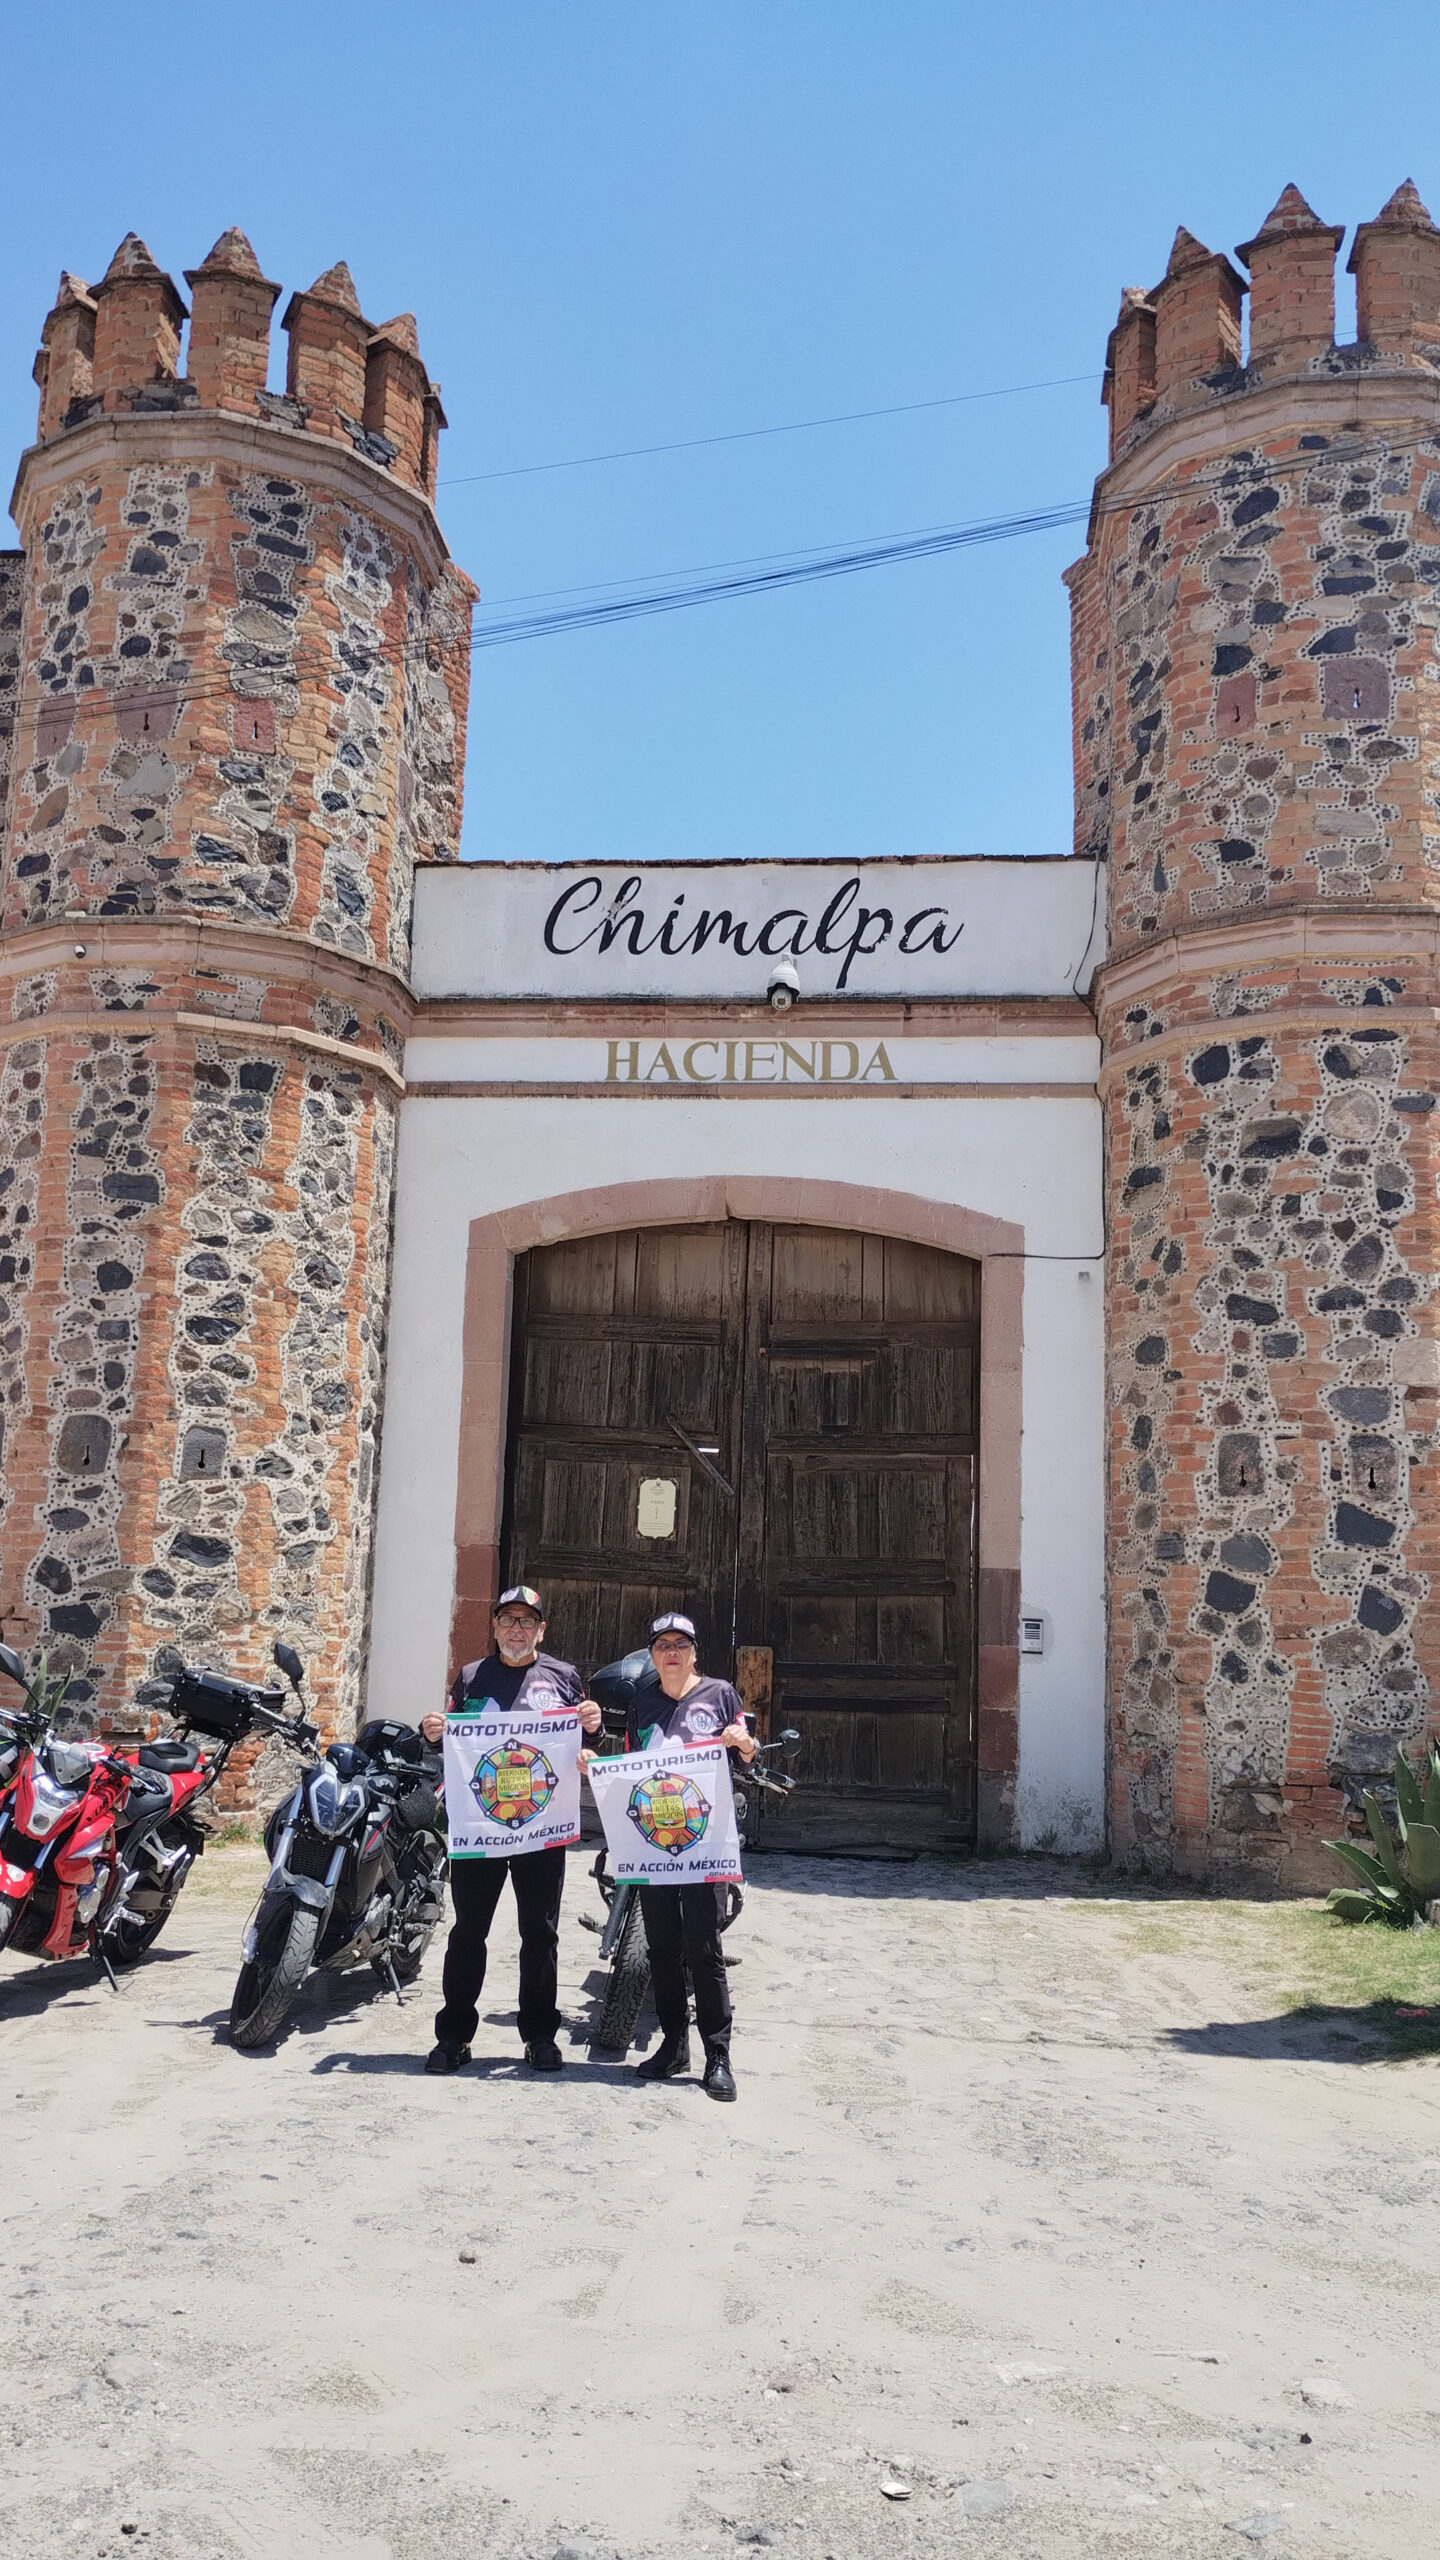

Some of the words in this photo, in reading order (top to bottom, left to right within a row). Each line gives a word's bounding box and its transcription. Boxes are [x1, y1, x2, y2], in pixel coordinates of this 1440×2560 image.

[544, 876, 964, 990] Chimalpa
[605, 1040, 898, 1082] HACIENDA
[446, 1718, 578, 1737] MOTOTURISMO
[592, 1749, 722, 1777] MOTOTURISMO
[548, 1776, 556, 1784] E
[453, 1837, 468, 1846] EN
[474, 1833, 523, 1846] ACCIÓN
[528, 1822, 575, 1840] MÉXICO
[618, 1863, 634, 1873] EN
[639, 1859, 684, 1872] ACCIÓN
[689, 1856, 737, 1870] MÉXICO
